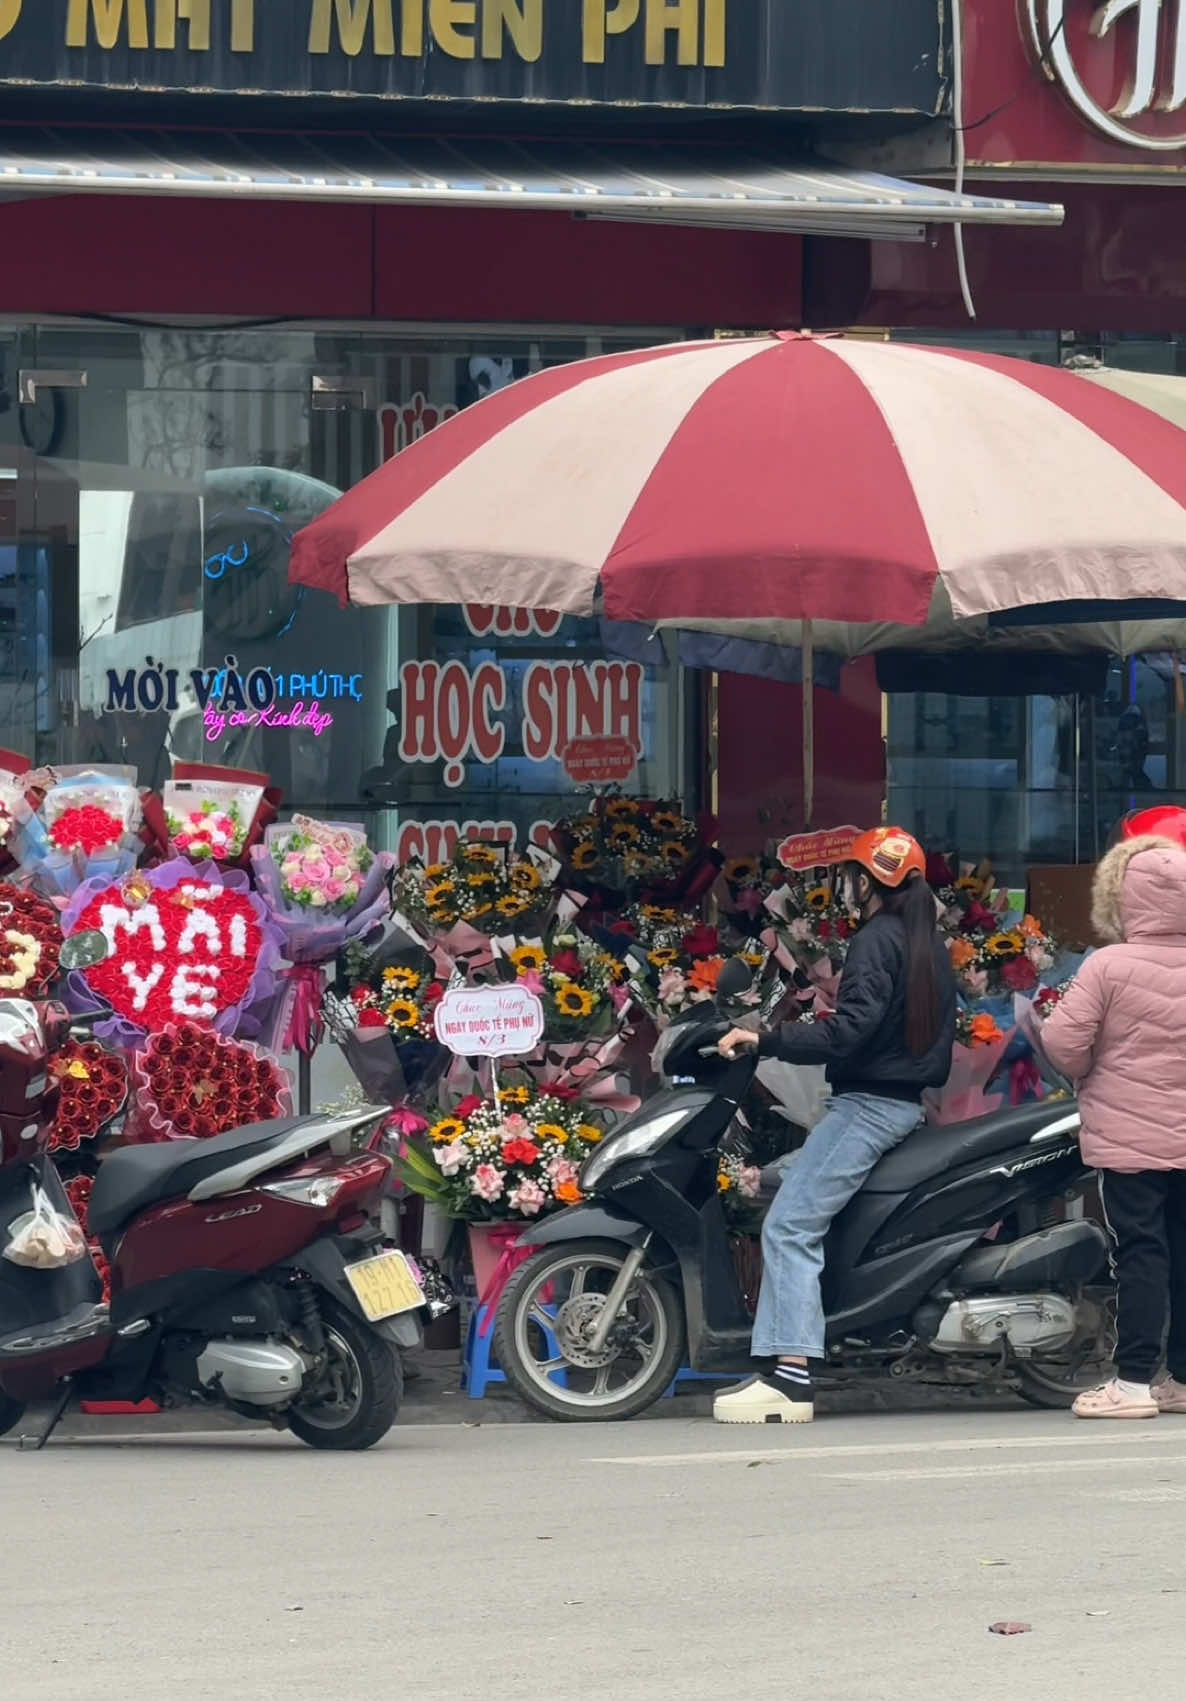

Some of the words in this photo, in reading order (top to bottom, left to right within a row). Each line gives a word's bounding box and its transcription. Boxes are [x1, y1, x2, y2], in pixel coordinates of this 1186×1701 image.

[104, 655, 179, 712] MỜI
[189, 655, 277, 712] VÀO
[398, 660, 506, 787] HỌC
[522, 660, 644, 760] SINH
